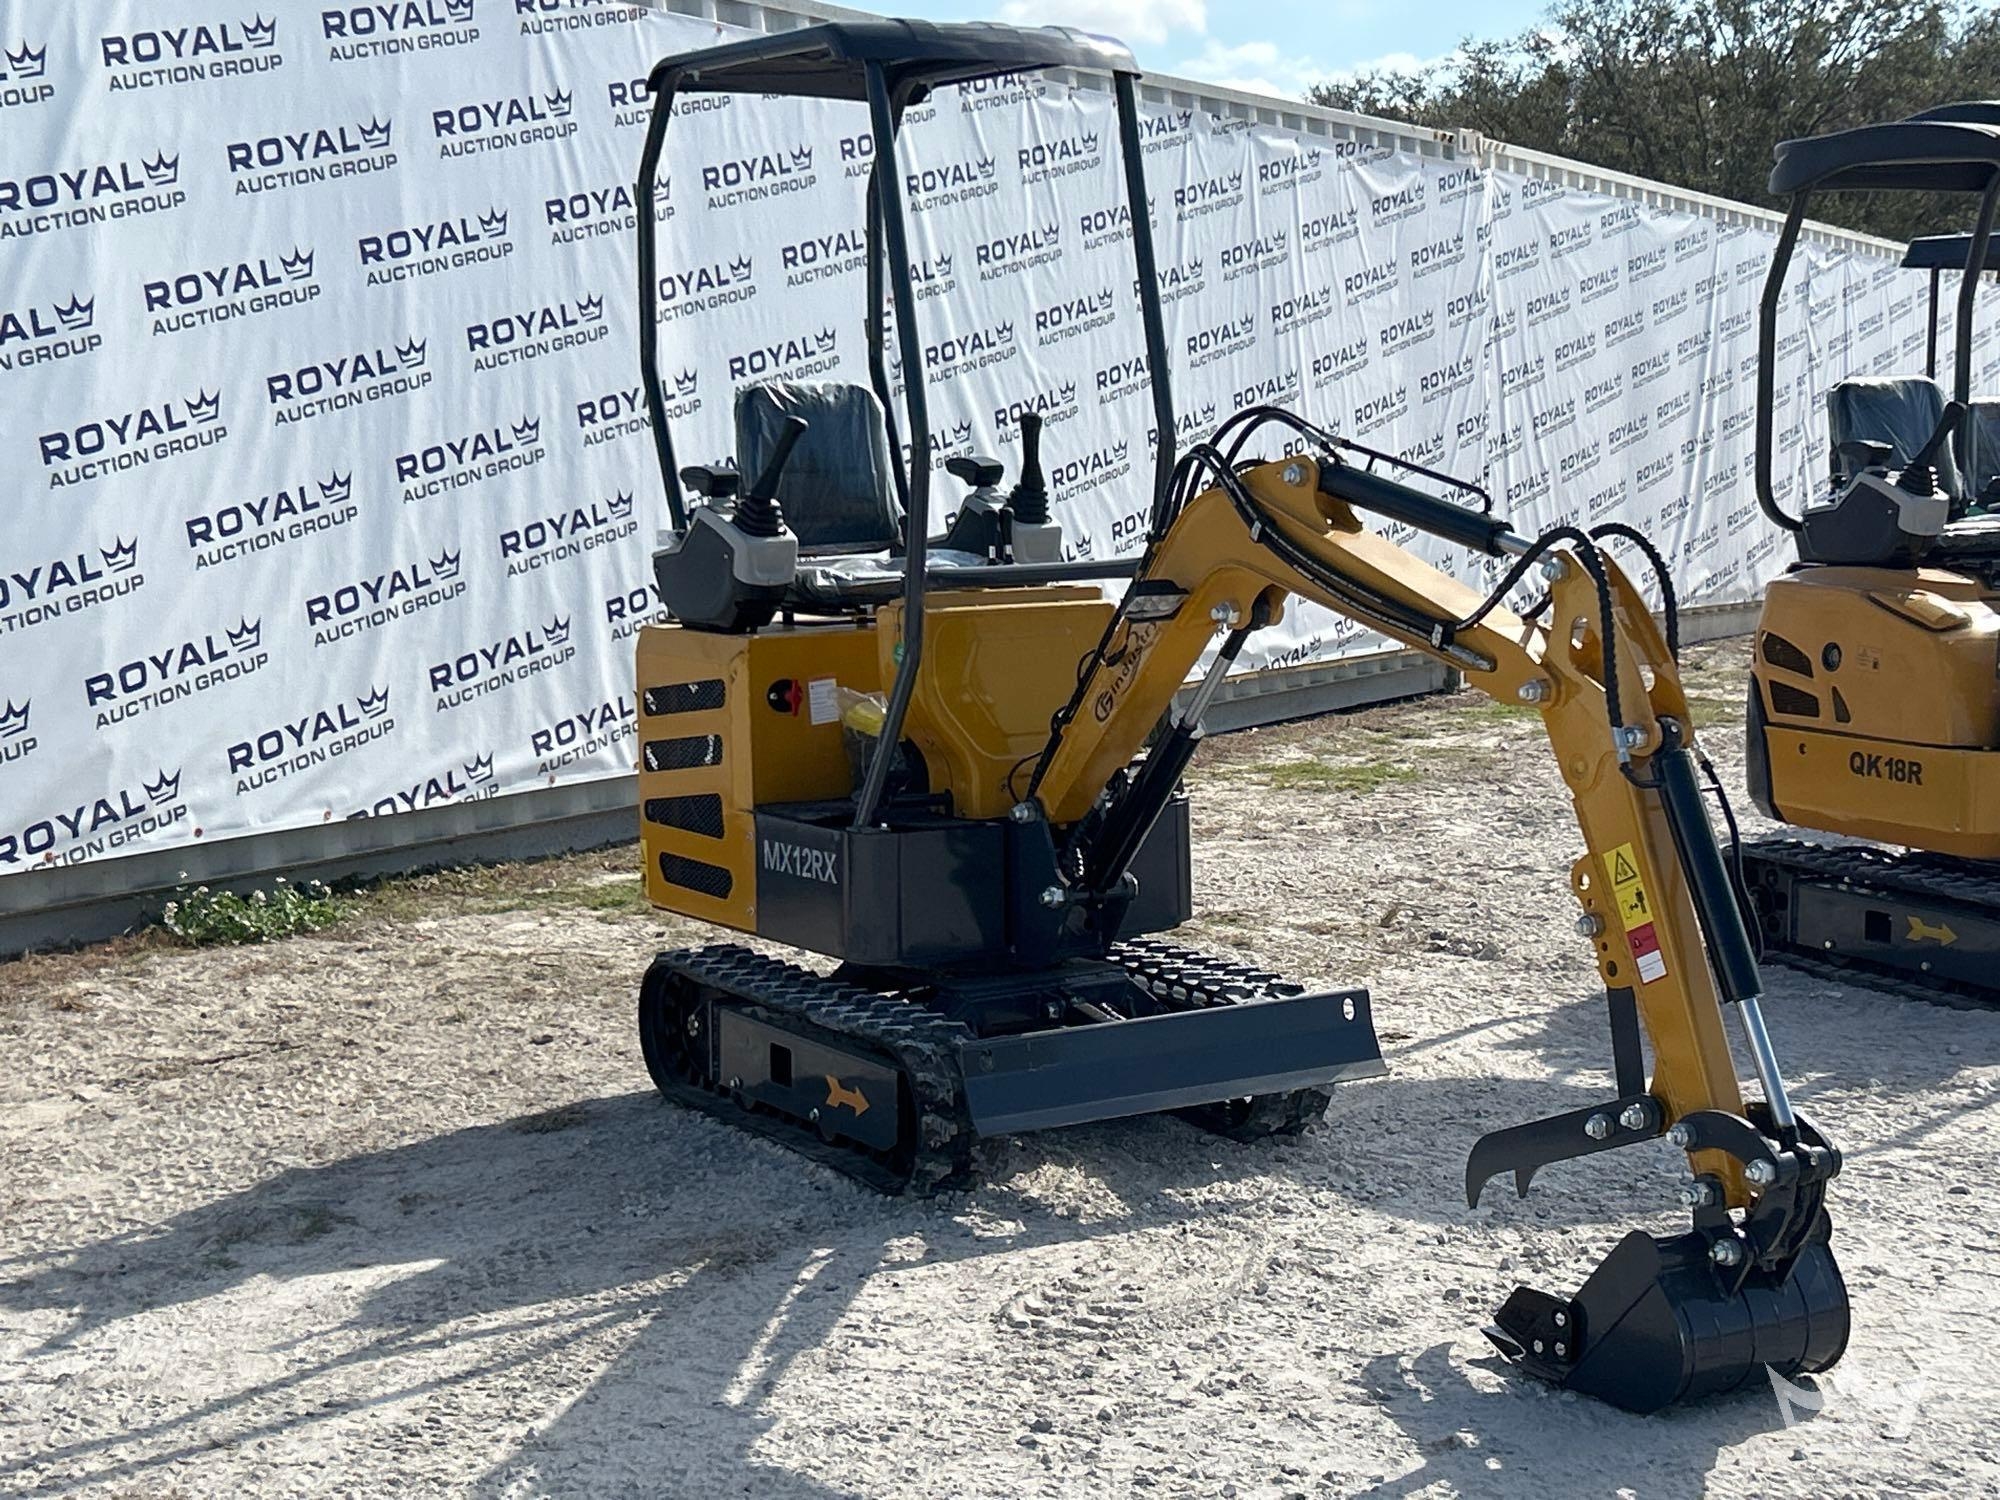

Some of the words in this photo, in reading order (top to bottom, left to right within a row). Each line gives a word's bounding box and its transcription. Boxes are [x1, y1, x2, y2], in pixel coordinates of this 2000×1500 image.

[322, 0, 446, 40] ROYAL
[520, 14, 592, 36] AUCTION
[595, 8, 648, 25] GROUP
[101, 24, 244, 67] ROYAL
[330, 37, 414, 62] AUCTION
[418, 28, 480, 50] GROUP
[110, 64, 206, 92] AUCTION
[210, 54, 282, 78] GROUP
[432, 96, 546, 138] ROYAL
[681, 95, 731, 115] GROUP
[961, 96, 1009, 114] AUCTION
[227, 126, 360, 172] ROYAL
[440, 133, 517, 159] AUCTION
[520, 122, 578, 144] GROUP
[1019, 138, 1082, 170] ROYAL
[236, 166, 326, 196] AUCTION
[329, 154, 398, 178] GROUP
[702, 153, 792, 191] ROYAL
[907, 162, 978, 196] ROYAL
[1258, 152, 1308, 182] ROYAL
[1438, 164, 1480, 192] ROYAL
[0, 162, 144, 214] ROYAL
[708, 186, 768, 210] AUCTION
[770, 175, 816, 196] GROUP
[910, 192, 958, 213] AUCTION
[960, 182, 998, 202] GROUP
[1174, 177, 1228, 208] ROYAL
[1372, 188, 1414, 216] ROYAL
[0, 206, 106, 240] AUCTION
[110, 191, 186, 218] GROUP
[552, 220, 622, 245] AUCTION
[1302, 212, 1347, 240] ROYAL
[358, 218, 480, 265] ROYAL
[782, 230, 864, 270] ROYAL
[976, 230, 1044, 266] ROYAL
[1221, 235, 1273, 268] ROYAL
[1411, 239, 1453, 267] ROYAL
[1496, 247, 1529, 269] ROYAL
[367, 256, 448, 287] AUCTION
[452, 242, 513, 268] GROUP
[787, 262, 842, 287] AUCTION
[980, 260, 1026, 281] AUCTION
[1028, 248, 1062, 268] GROUP
[1345, 264, 1387, 294] ROYAL
[144, 260, 282, 312] ROYAL
[708, 287, 756, 308] GROUP
[916, 280, 956, 300] GROUP
[1448, 286, 1487, 317] ROYAL
[153, 300, 246, 336] AUCTION
[250, 284, 320, 312] GROUP
[1036, 296, 1098, 332] ROYAL
[1272, 292, 1320, 324] ROYAL
[466, 304, 578, 352] ROYAL
[1039, 324, 1081, 346] AUCTION
[1083, 312, 1115, 332] GROUP
[1188, 322, 1240, 356] ROYAL
[1380, 316, 1422, 346] ROYAL
[18, 334, 102, 367] GROUP
[474, 340, 550, 372] AUCTION
[552, 326, 608, 352] GROUP
[729, 337, 816, 380] ROYAL
[926, 329, 996, 368] ROYAL
[930, 359, 977, 384] AUCTION
[979, 346, 1016, 368] GROUP
[1312, 344, 1356, 377] ROYAL
[266, 350, 398, 404] ROYAL
[795, 358, 840, 387] GROUP
[1420, 360, 1462, 392] ROYAL
[275, 390, 363, 426] AUCTION
[366, 372, 432, 401] GROUP
[1100, 382, 1139, 406] AUCTION
[1234, 377, 1284, 410] ROYAL
[1355, 392, 1396, 425] ROYAL
[38, 404, 187, 466] ROYAL
[584, 416, 652, 448] AUCTION
[1044, 406, 1078, 427] GROUP
[50, 448, 150, 490] AUCTION
[154, 426, 228, 460] GROUP
[396, 428, 513, 484] ROYAL
[1052, 448, 1114, 489] ROYAL
[403, 467, 482, 504] AUCTION
[485, 448, 545, 478] GROUP
[1056, 478, 1097, 504] AUCTION
[1098, 463, 1130, 484] GROUP
[186, 486, 320, 548] ROYAL
[500, 504, 608, 558] ROYAL
[196, 528, 285, 570] AUCTION
[288, 506, 358, 539] GROUP
[507, 540, 580, 578] AUCTION
[584, 521, 638, 550] GROUP
[66, 574, 144, 612] GROUP
[306, 564, 432, 626] ROYAL
[314, 605, 398, 648] AUCTION
[402, 583, 466, 615] GROUP
[84, 636, 228, 707] ROYAL
[429, 631, 544, 693] ROYAL
[437, 670, 514, 712] AUCTION
[517, 647, 575, 679] GROUP
[96, 680, 191, 730] AUCTION
[195, 653, 269, 691] GROUP
[227, 704, 360, 774] ROYAL
[531, 697, 634, 757] ROYAL
[236, 756, 326, 796] AUCTION
[330, 718, 395, 757] GROUP
[537, 734, 608, 776] AUCTION
[1849, 751, 1923, 785] QK18R
[0, 790, 146, 864] ROYAL
[109, 804, 187, 848] GROUP
[764, 840, 837, 884] MX12RX
